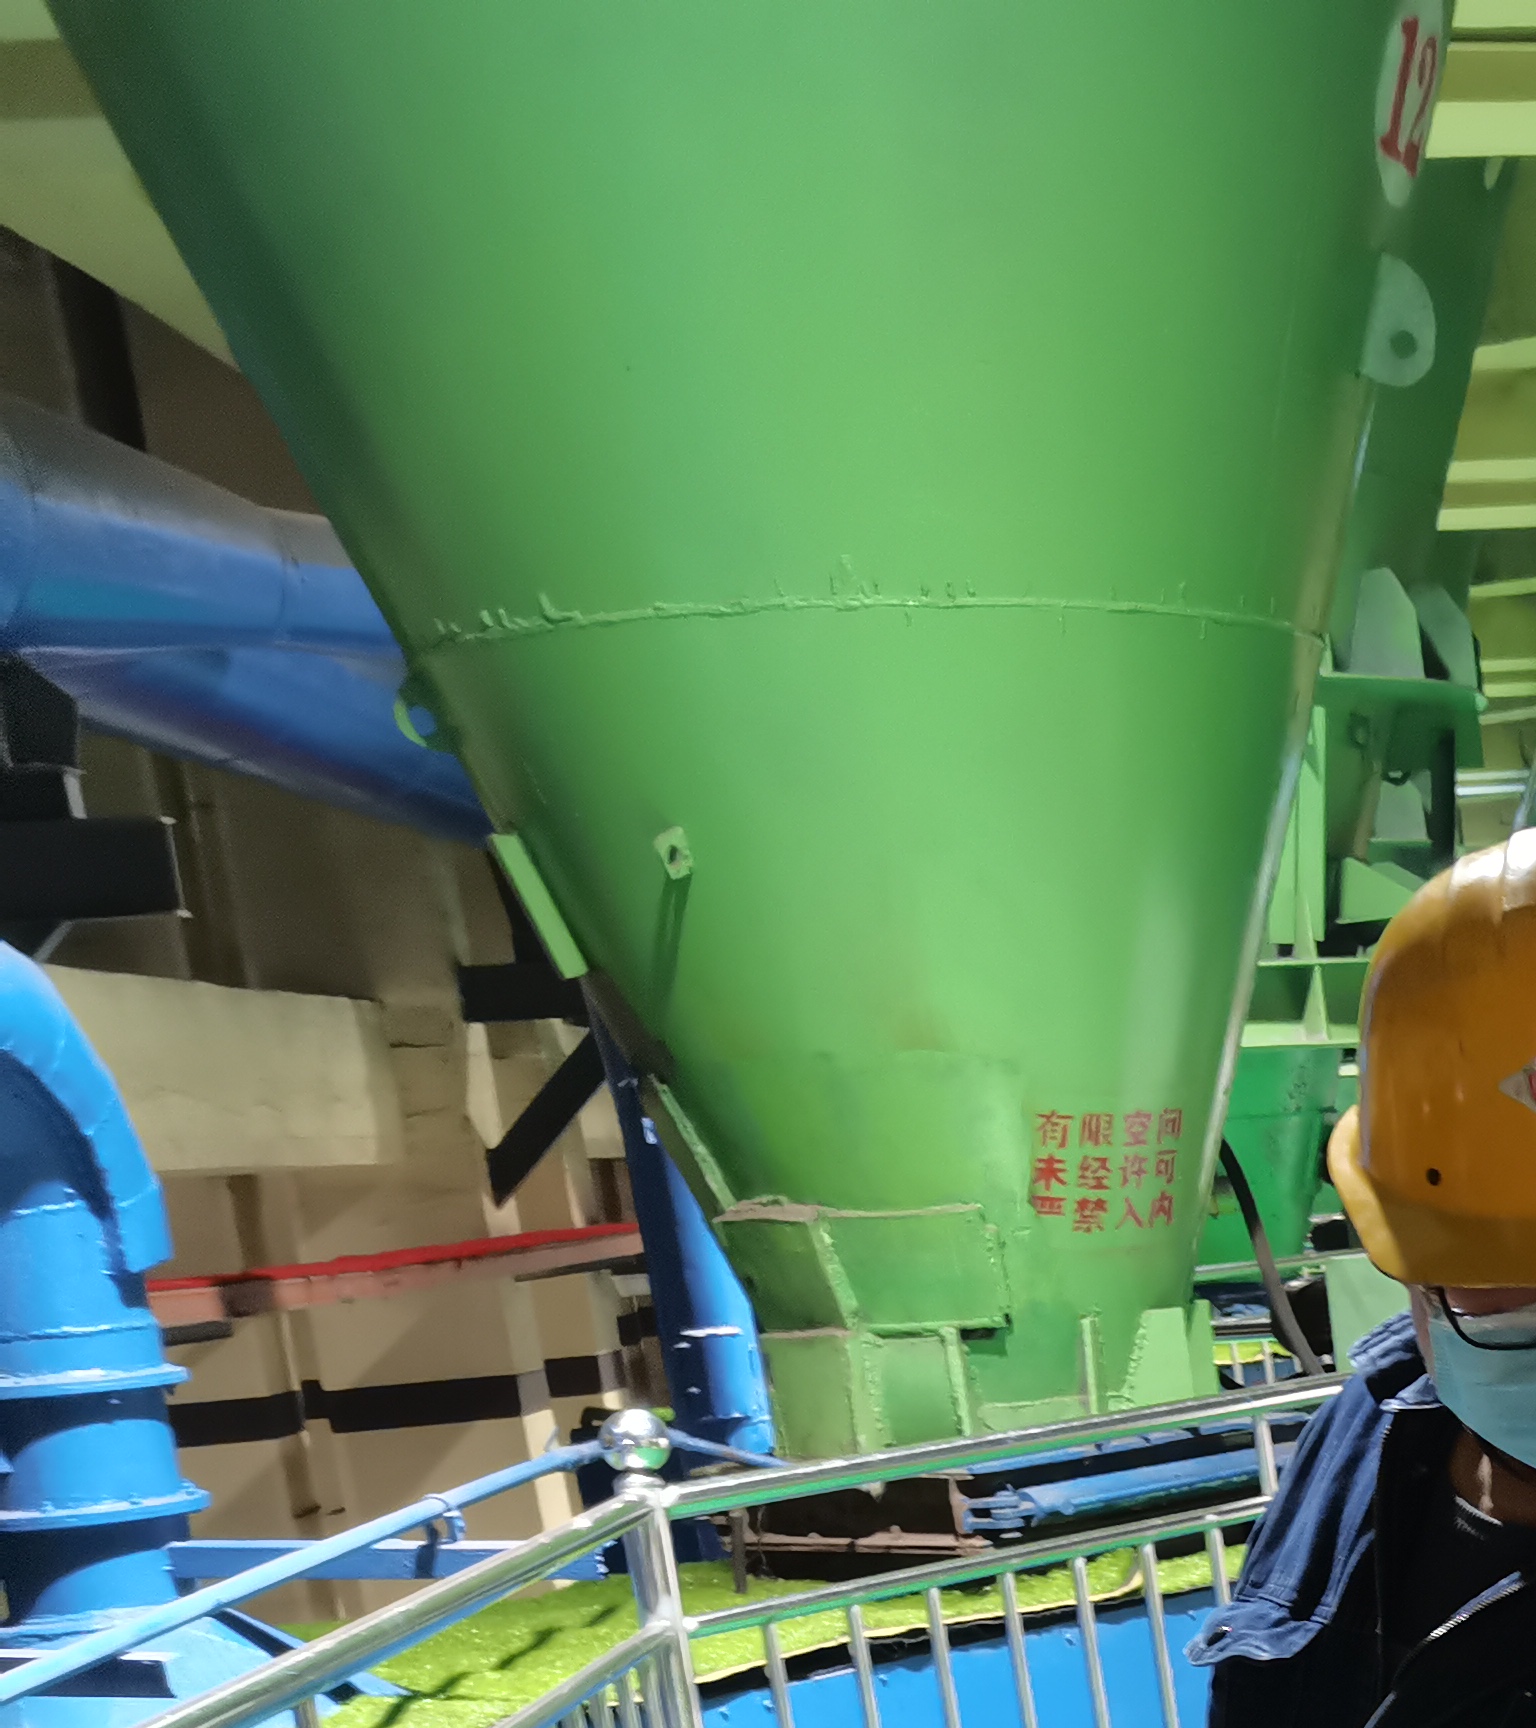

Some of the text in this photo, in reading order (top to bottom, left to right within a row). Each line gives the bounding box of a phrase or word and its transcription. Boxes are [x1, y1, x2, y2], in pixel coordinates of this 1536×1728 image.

[1379, 15, 1438, 178] 12
[1036, 1107, 1183, 1149] 有限空间
[1032, 1149, 1178, 1191] 未经许可
[1032, 1191, 1174, 1234] 严禁入内
